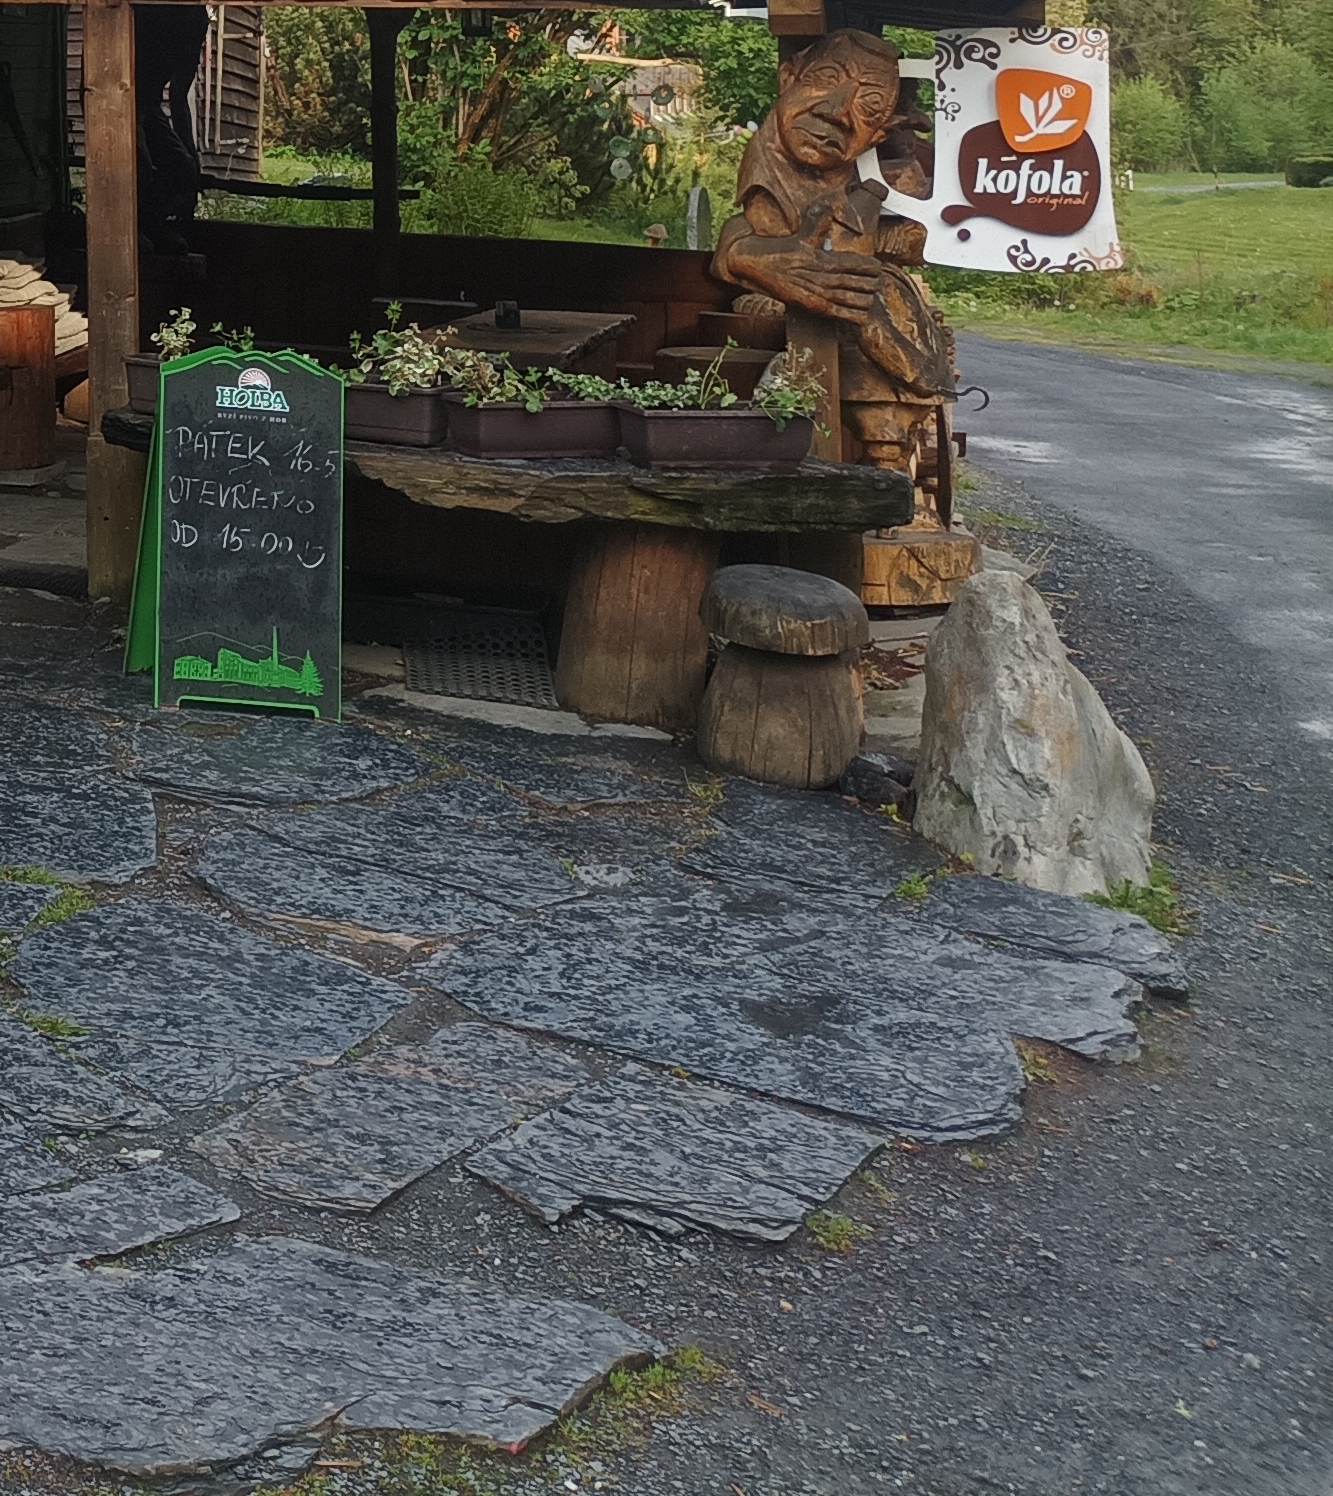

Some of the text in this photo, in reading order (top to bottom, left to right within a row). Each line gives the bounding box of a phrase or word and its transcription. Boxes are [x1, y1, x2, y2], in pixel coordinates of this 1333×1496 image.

[1027, 191, 1089, 211] original
[216, 386, 289, 412] HOLBA
[171, 520, 198, 547] OD
